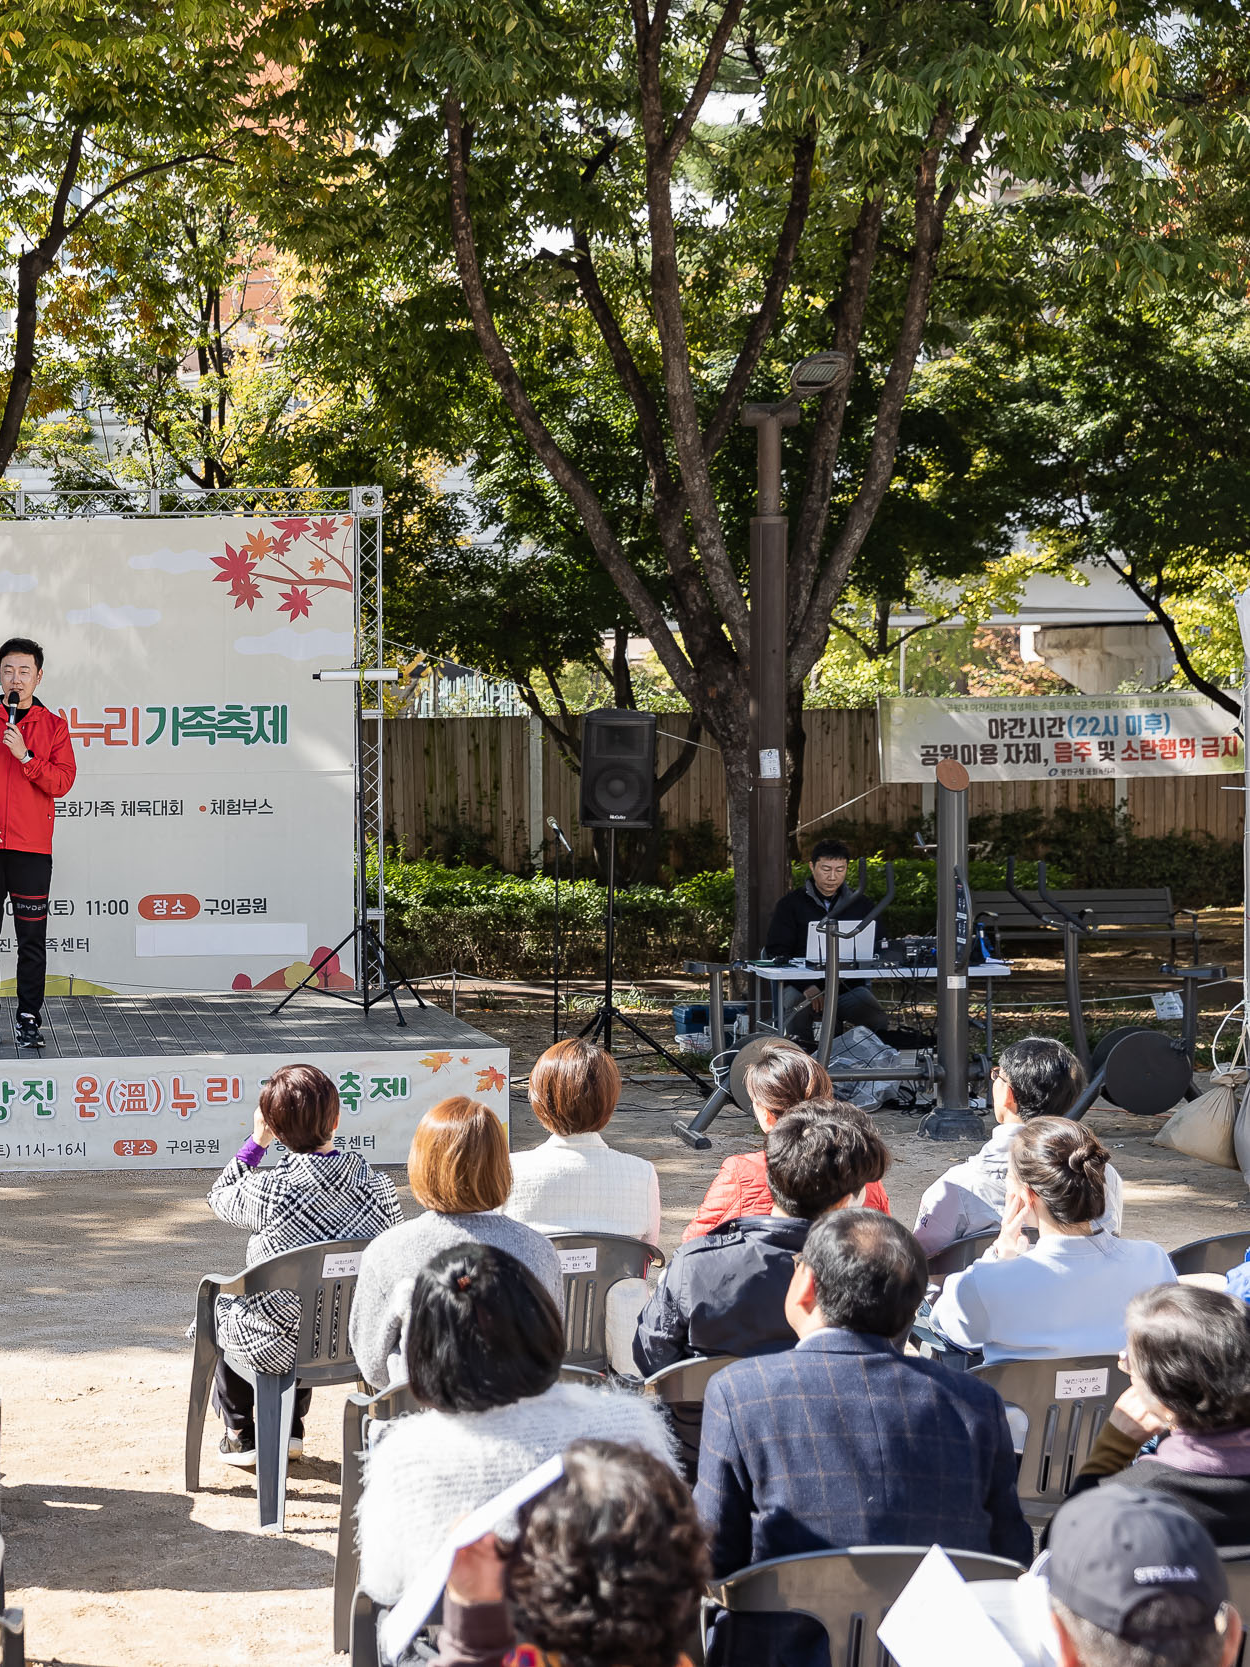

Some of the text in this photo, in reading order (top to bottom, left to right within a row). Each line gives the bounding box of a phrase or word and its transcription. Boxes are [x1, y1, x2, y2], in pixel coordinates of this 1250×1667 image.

[146, 704, 288, 745] 가족축제
[1125, 712, 1171, 736] 이후)
[920, 736, 1238, 767] 공원이용 자제, 음주 및 소란행위 금지
[120, 799, 184, 817] 체육대회
[210, 798, 274, 816] 체험부스
[85, 899, 129, 916] 11:00
[152, 898, 187, 916] 장소
[203, 897, 268, 916] 구의공원
[16, 1142, 86, 1158] 11시~16시
[122, 1141, 153, 1156] 장소
[165, 1139, 220, 1154] 구의공원
